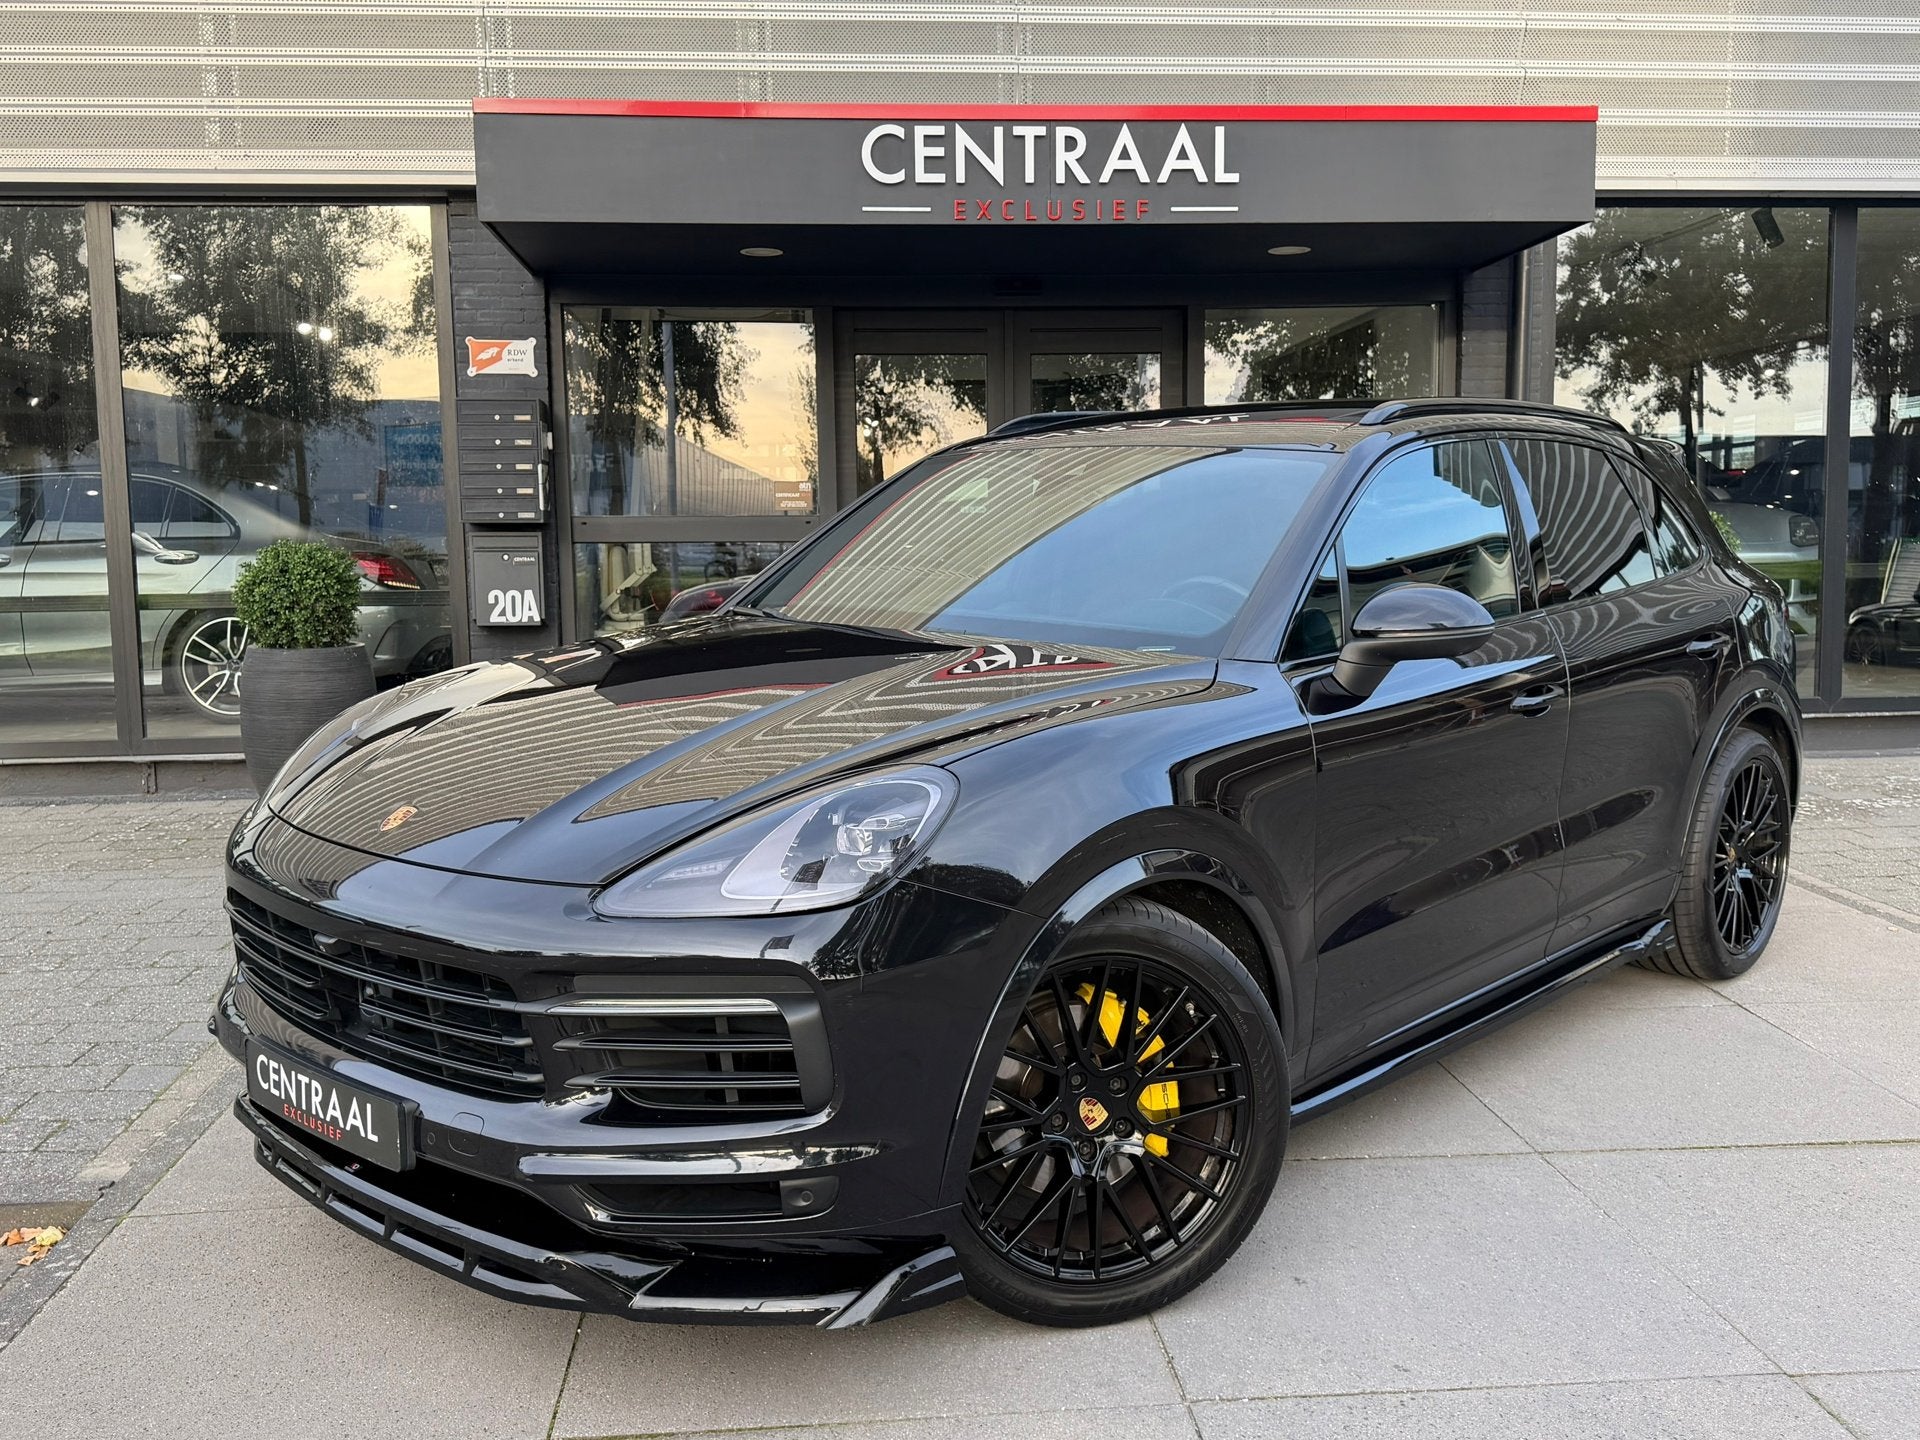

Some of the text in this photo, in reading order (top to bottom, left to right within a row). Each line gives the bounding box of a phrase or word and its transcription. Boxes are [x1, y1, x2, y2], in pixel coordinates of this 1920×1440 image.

[861, 122, 1240, 187] CENTRAAL
[953, 199, 1151, 222] EXCLUSIEF
[507, 348, 528, 356] RDW
[487, 589, 541, 623] 20A
[256, 1053, 379, 1143] CENTRAAL
[283, 1103, 344, 1142] EXCLUSIEF
